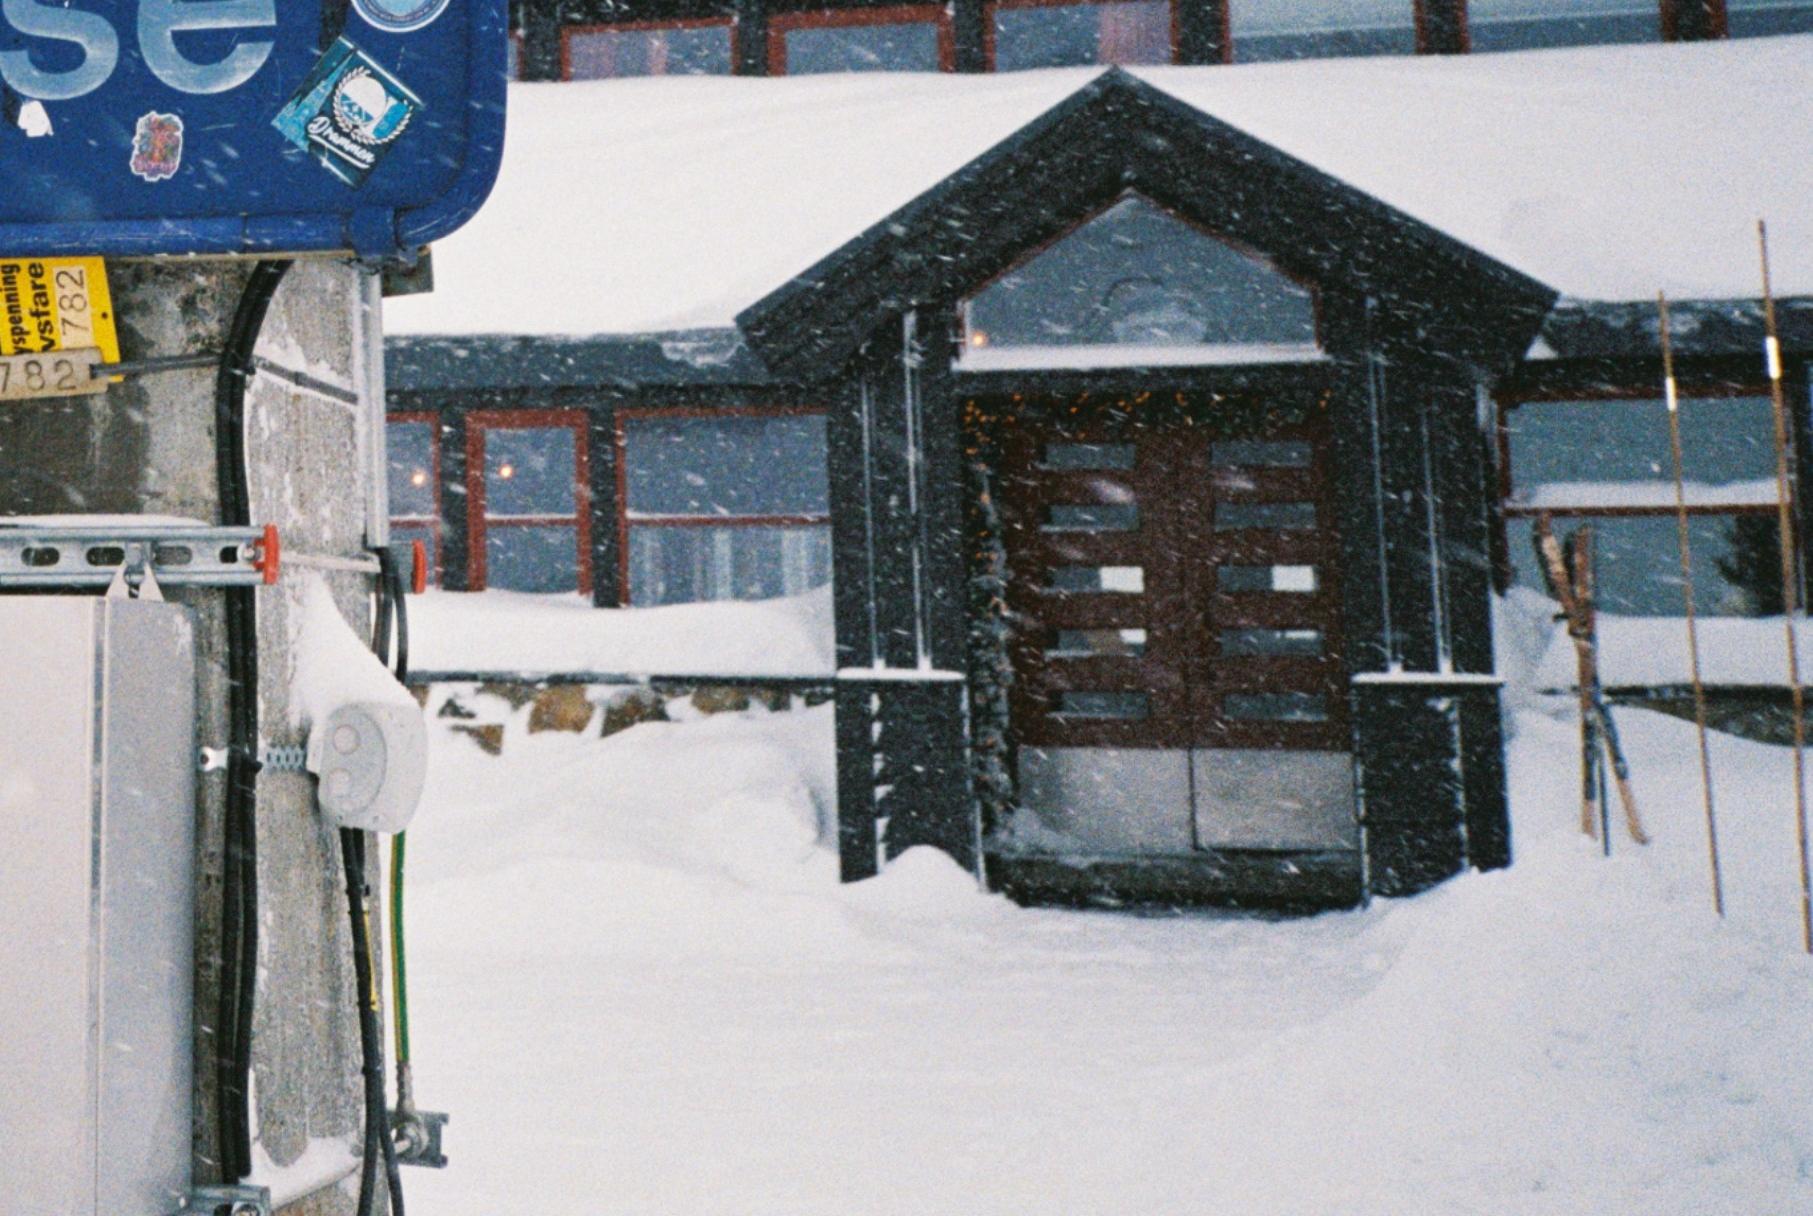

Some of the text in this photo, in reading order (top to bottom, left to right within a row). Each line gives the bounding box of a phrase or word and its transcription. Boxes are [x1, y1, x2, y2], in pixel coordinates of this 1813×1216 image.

[307, 116, 375, 163] Drammen
[28, 262, 56, 353] vsfare
[56, 269, 89, 335] 782
